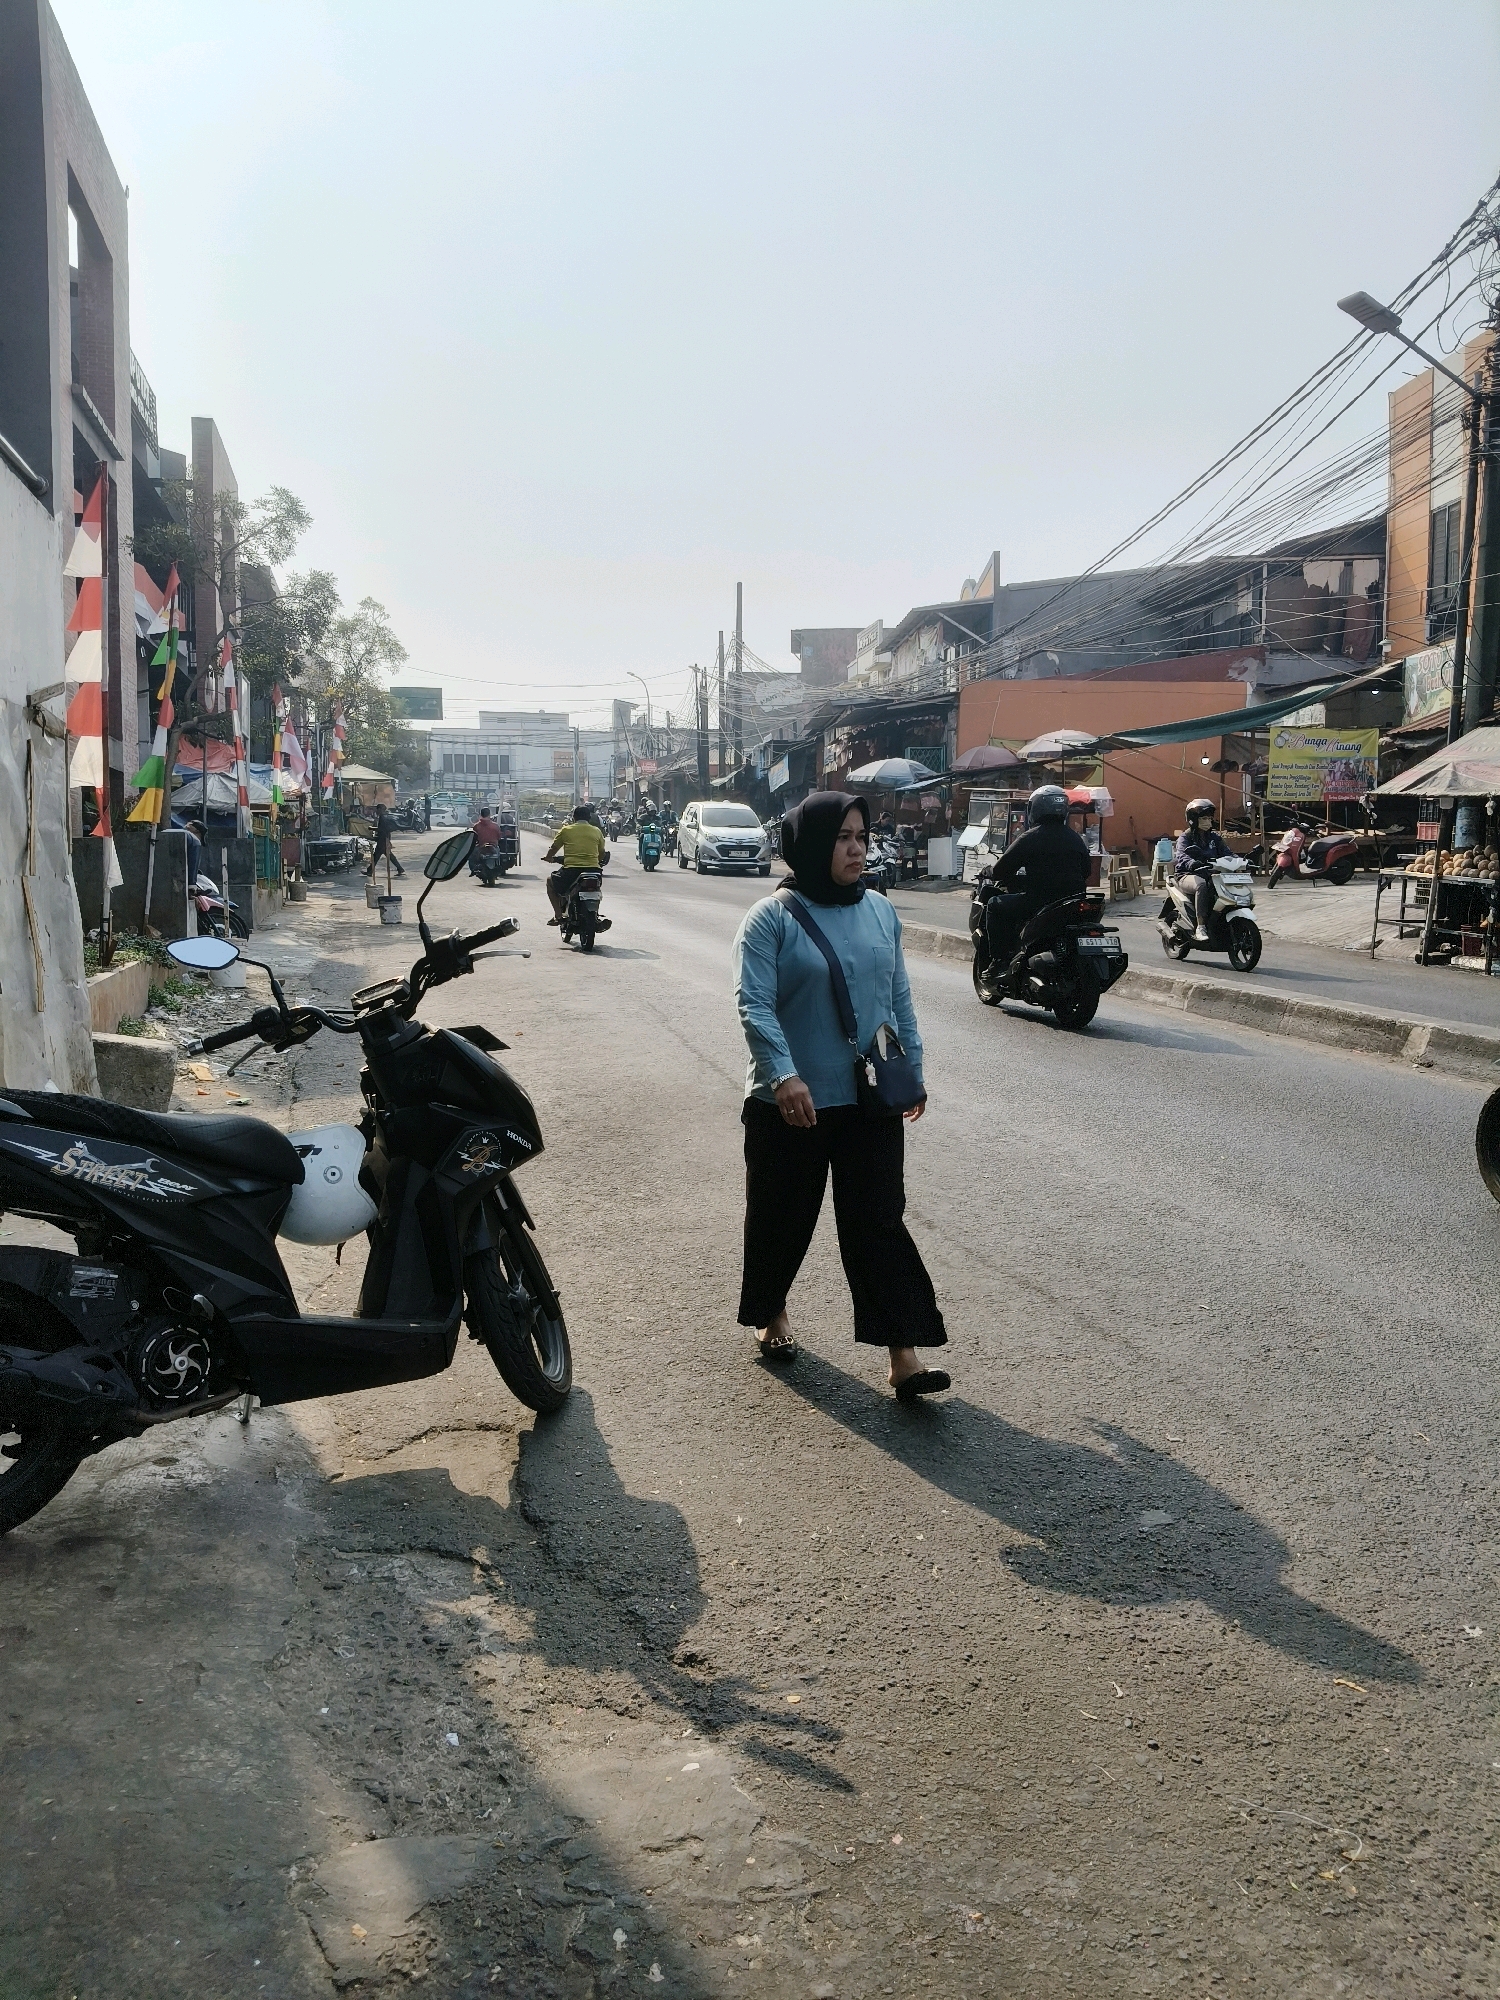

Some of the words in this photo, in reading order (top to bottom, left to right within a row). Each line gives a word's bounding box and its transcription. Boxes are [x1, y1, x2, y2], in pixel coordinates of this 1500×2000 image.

[1287, 733, 1328, 749] Bunga
[1316, 737, 1362, 753] Minang
[506, 1129, 532, 1151] HONDA
[50, 1147, 148, 1192] STREET
